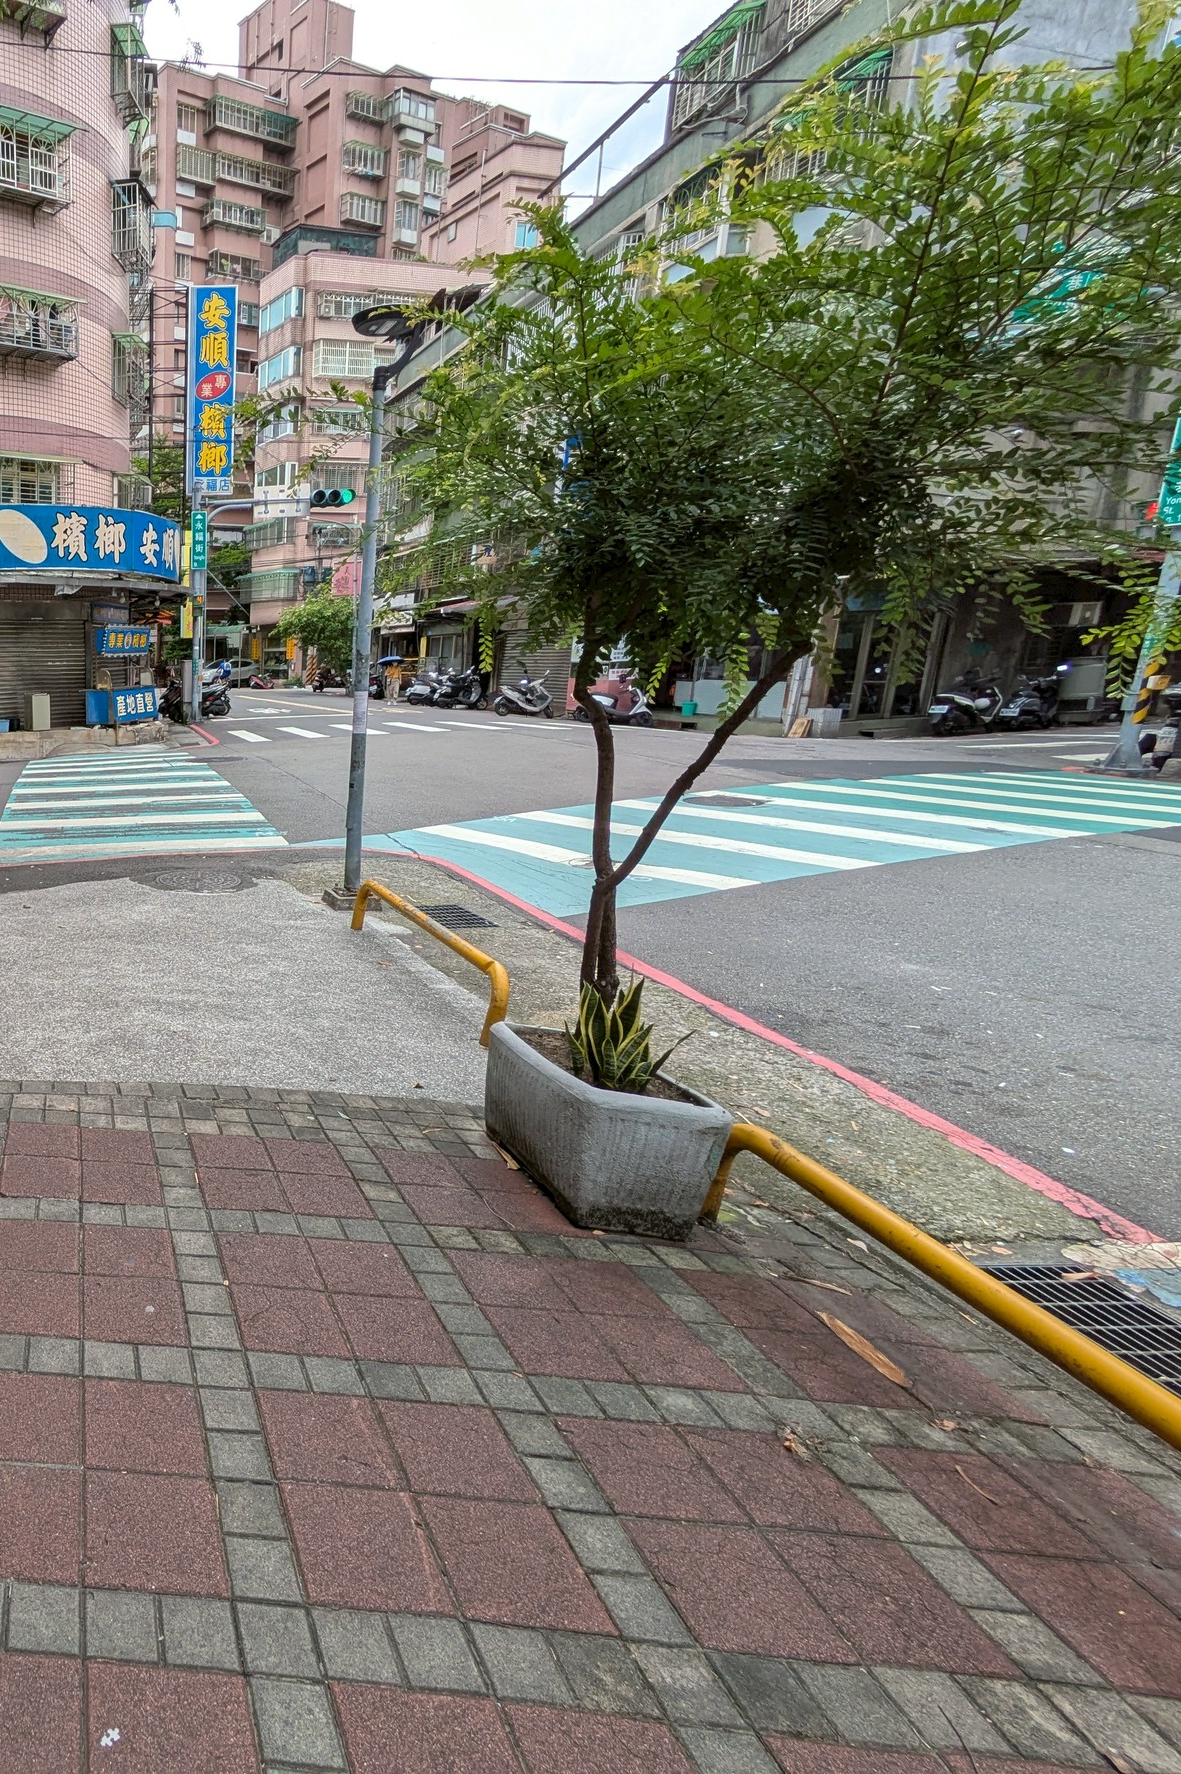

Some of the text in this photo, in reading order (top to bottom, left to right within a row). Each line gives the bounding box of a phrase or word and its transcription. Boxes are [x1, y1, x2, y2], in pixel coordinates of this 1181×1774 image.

[198, 291, 231, 368] 安順
[200, 374, 228, 397] 專業
[139, 522, 174, 571] 安順
[195, 521, 204, 553] 永福街
[116, 692, 154, 716] 產地直營
